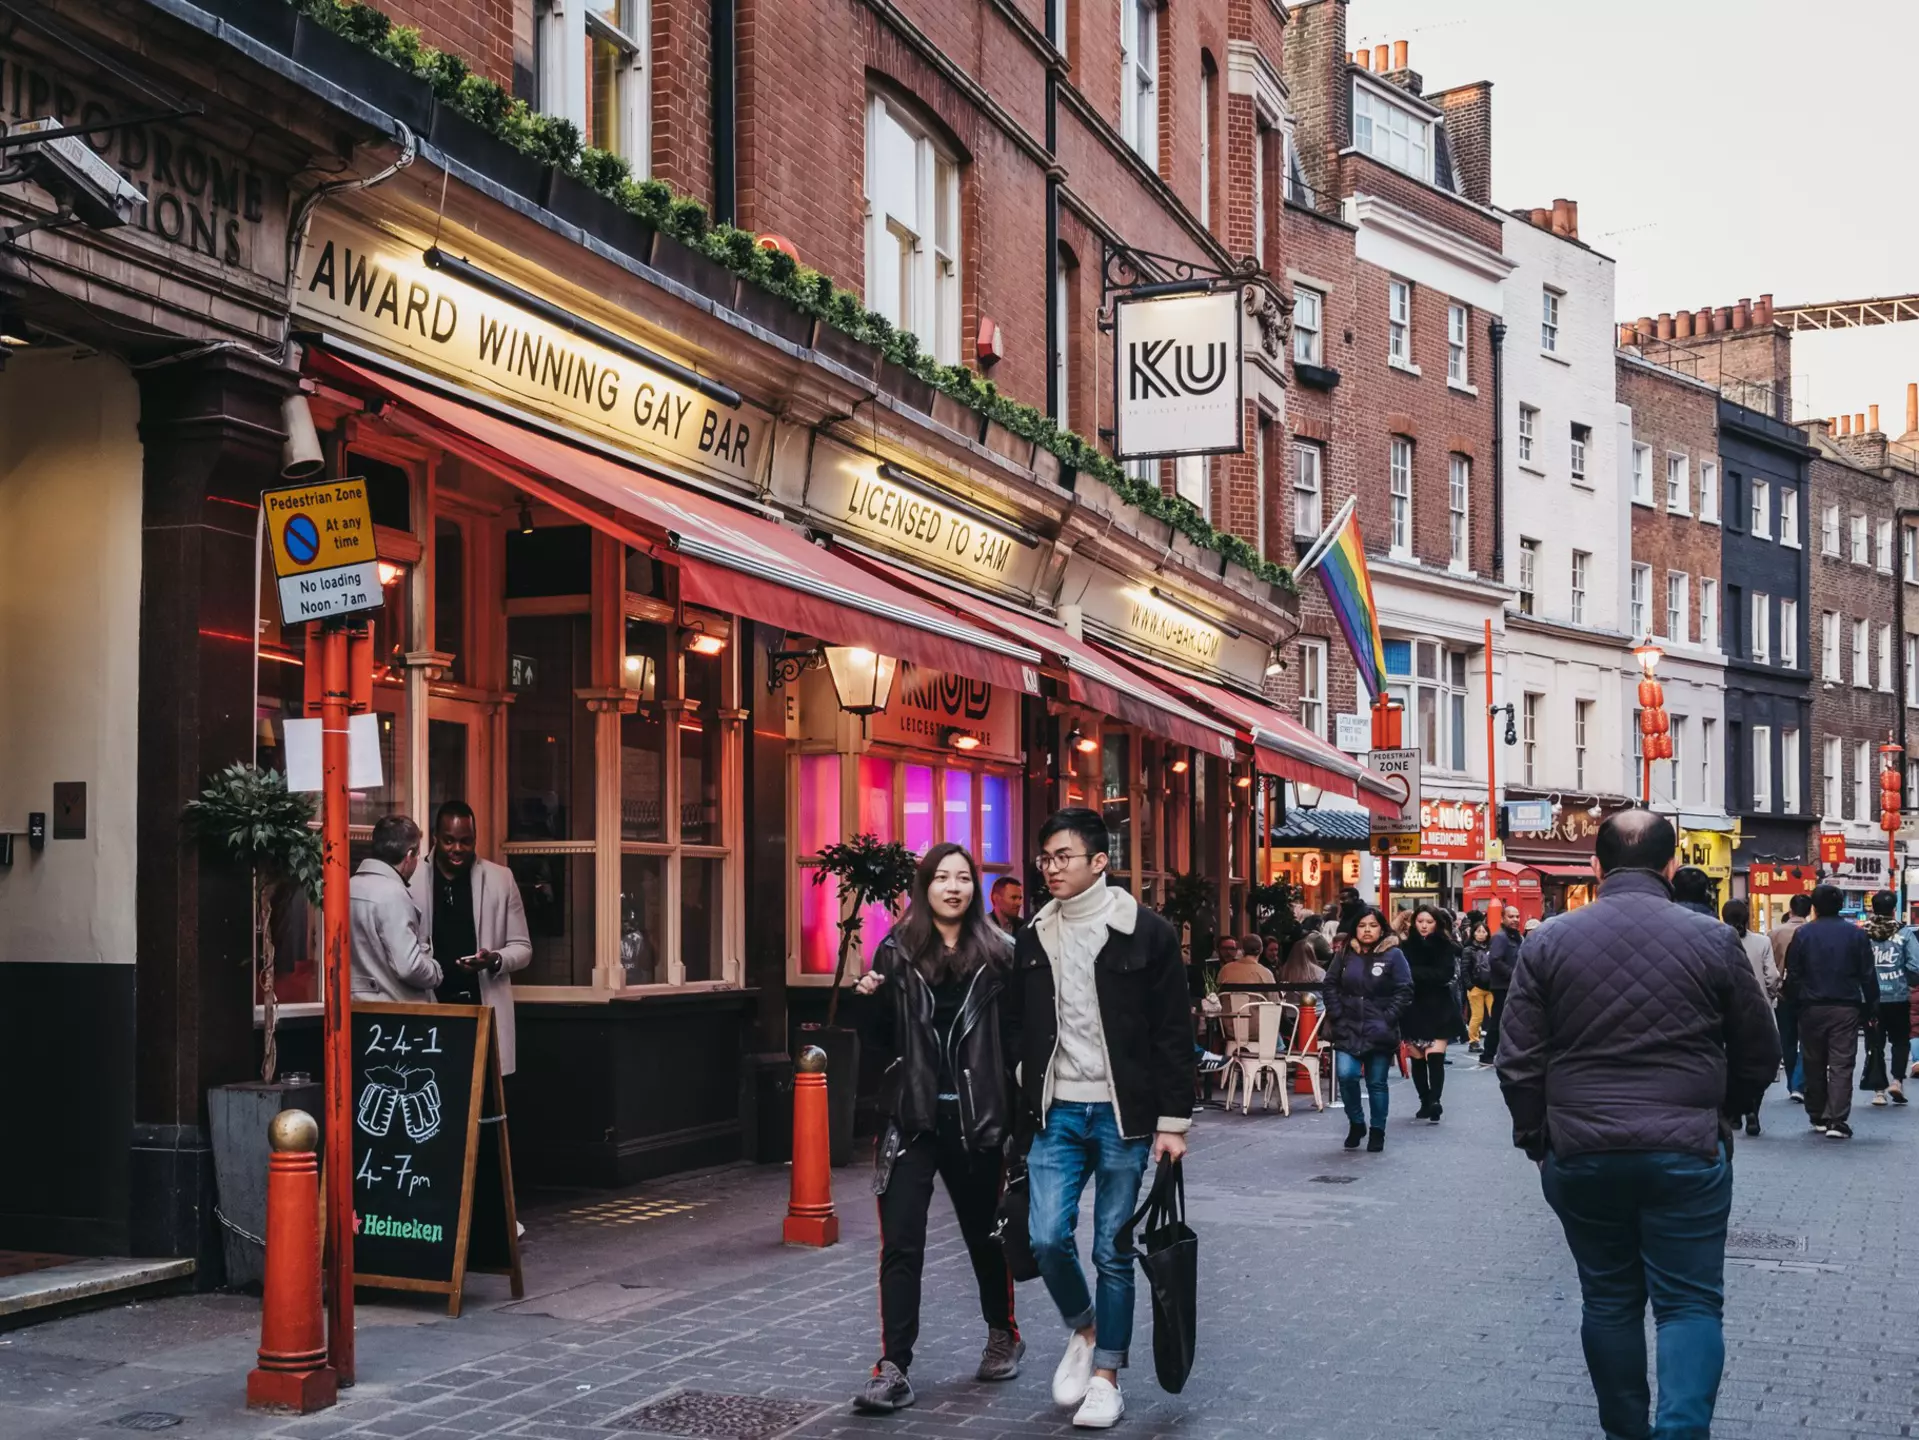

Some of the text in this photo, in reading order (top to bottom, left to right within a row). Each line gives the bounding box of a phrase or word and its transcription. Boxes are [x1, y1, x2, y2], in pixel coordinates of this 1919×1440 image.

[309, 240, 750, 468] AWARD WINNING GAY BAR
[1129, 338, 1227, 401] KU
[270, 487, 362, 511] Pedestrian Zone
[326, 516, 362, 532] At any
[847, 477, 1012, 573] LICENSED TO 3AM
[334, 535, 359, 549] time
[300, 573, 362, 594] No loading
[300, 599, 331, 615] Noon
[1130, 603, 1220, 660] WWW.KU-BAR.COM
[1374, 752, 1415, 760] PEDESTRIAN
[1379, 761, 1409, 771] ZONE
[1428, 832, 1468, 846] MEDICINE
[365, 1024, 443, 1056] 2-4-1
[364, 1214, 443, 1243] Heineken
